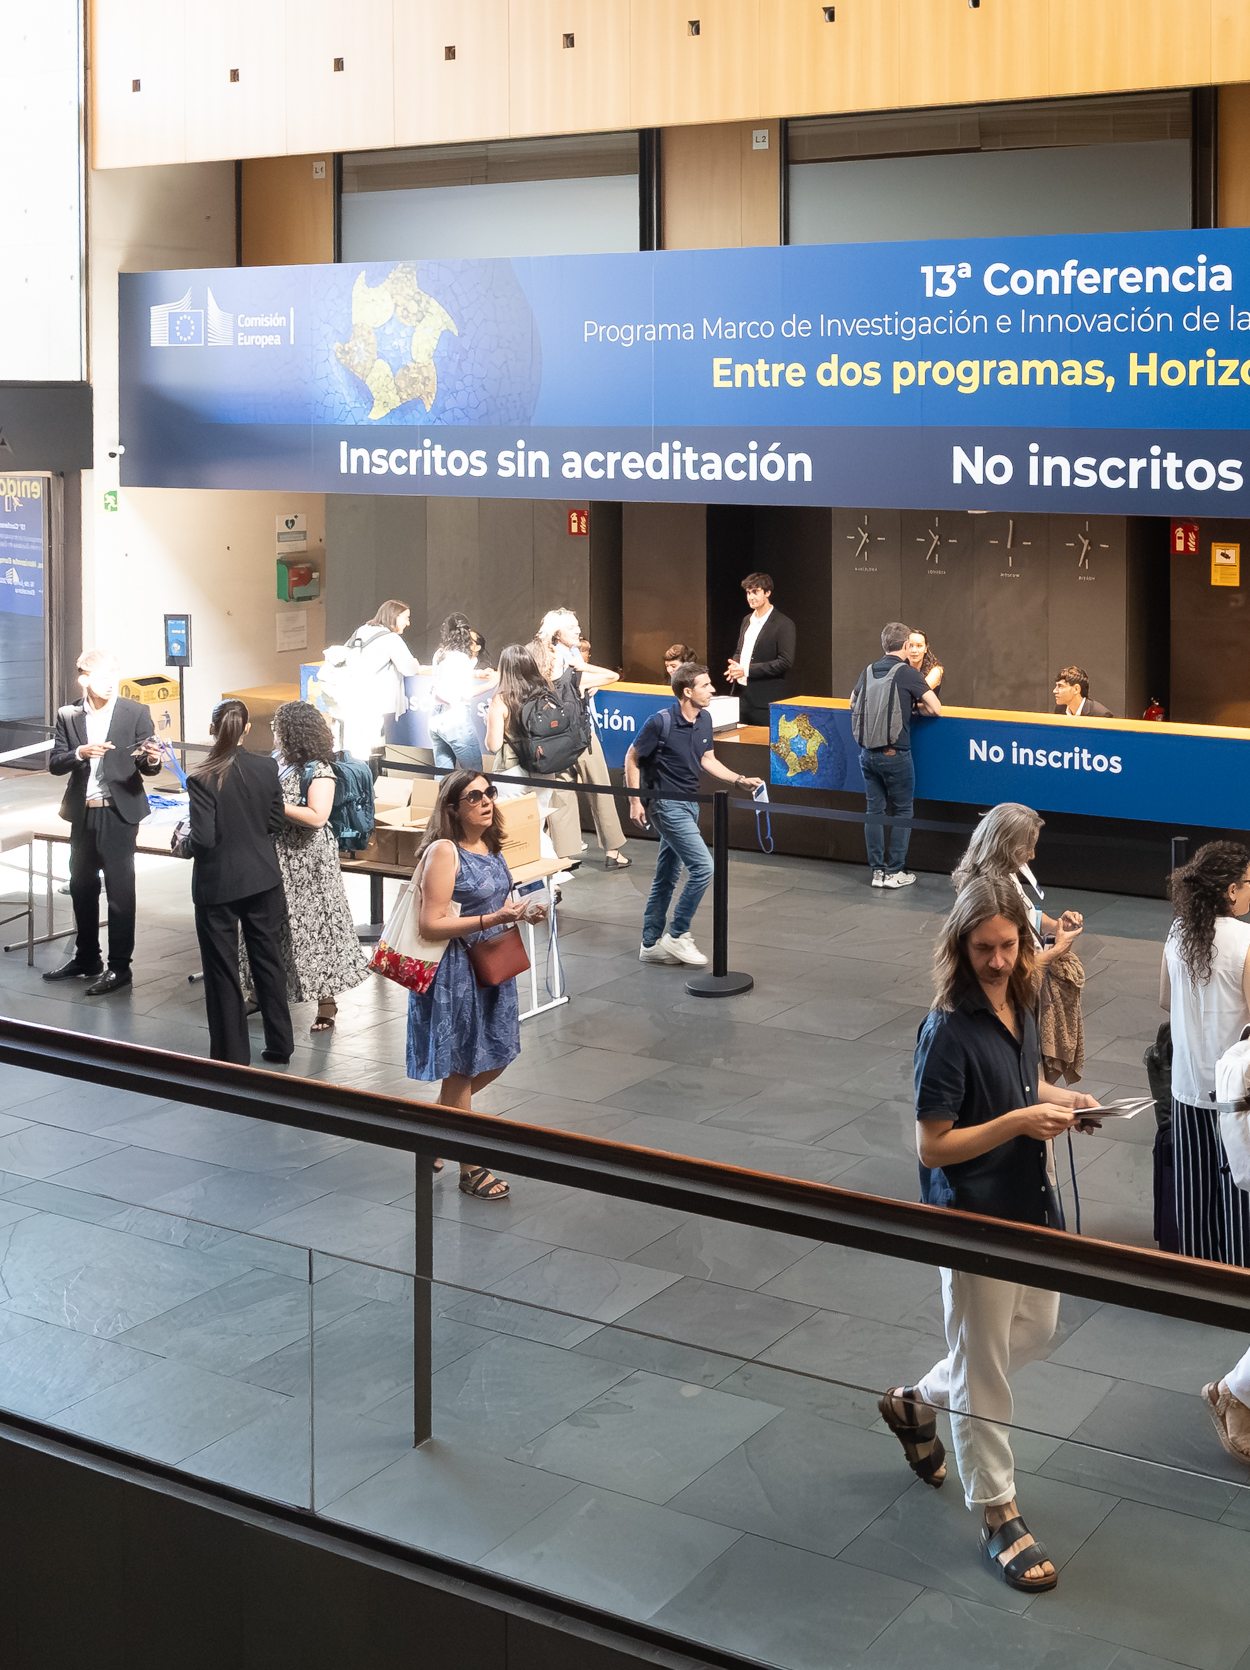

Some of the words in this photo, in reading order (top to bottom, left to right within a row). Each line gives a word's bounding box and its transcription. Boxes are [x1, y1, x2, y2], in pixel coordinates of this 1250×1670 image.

[920, 262, 972, 298] 13ª
[983, 253, 1233, 297] Conferencia
[237, 312, 287, 328] Comisión
[237, 332, 282, 349] Europea
[584, 320, 694, 348] Programa
[702, 316, 775, 340] Marco
[781, 313, 812, 338] de
[820, 309, 988, 341] Investigación
[996, 314, 1012, 334] e
[1021, 306, 1173, 333] Innovación
[1182, 304, 1220, 332] de
[712, 356, 807, 388] Entre
[815, 353, 882, 387] dos
[892, 357, 1116, 395] programas,
[339, 438, 488, 477] Inscritos
[497, 438, 550, 478] sin
[561, 440, 813, 482] acreditación
[952, 445, 1014, 486] No
[1028, 442, 1244, 492] inscritos
[969, 738, 1005, 764] No
[1010, 740, 1123, 775] inscritos
